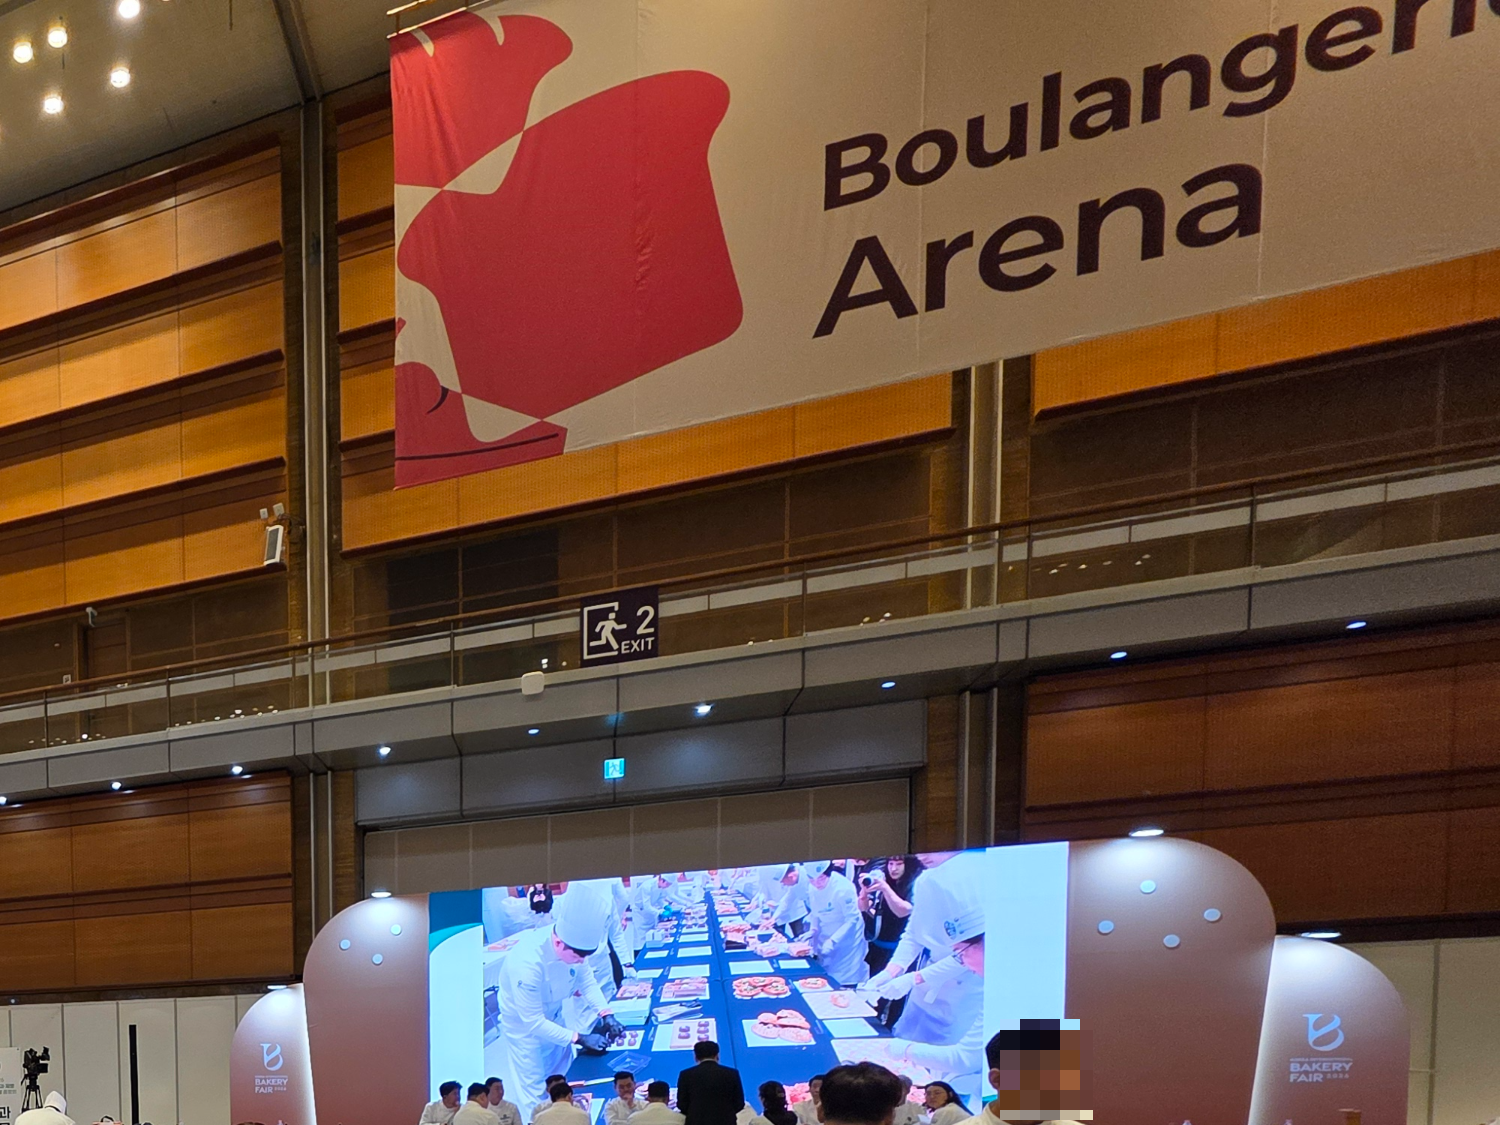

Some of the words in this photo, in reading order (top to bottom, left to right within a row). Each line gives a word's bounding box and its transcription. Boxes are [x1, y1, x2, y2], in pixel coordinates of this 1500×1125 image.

[823, 0, 1500, 211] Boulanger
[812, 163, 1263, 340] Arena
[636, 605, 655, 635] 2
[621, 637, 655, 654] EXIT
[1289, 1062, 1353, 1072] BAKERY
[254, 1078, 289, 1086] BAKERY
[1289, 1073, 1325, 1083] FAIR
[254, 1086, 273, 1094] FAIR
